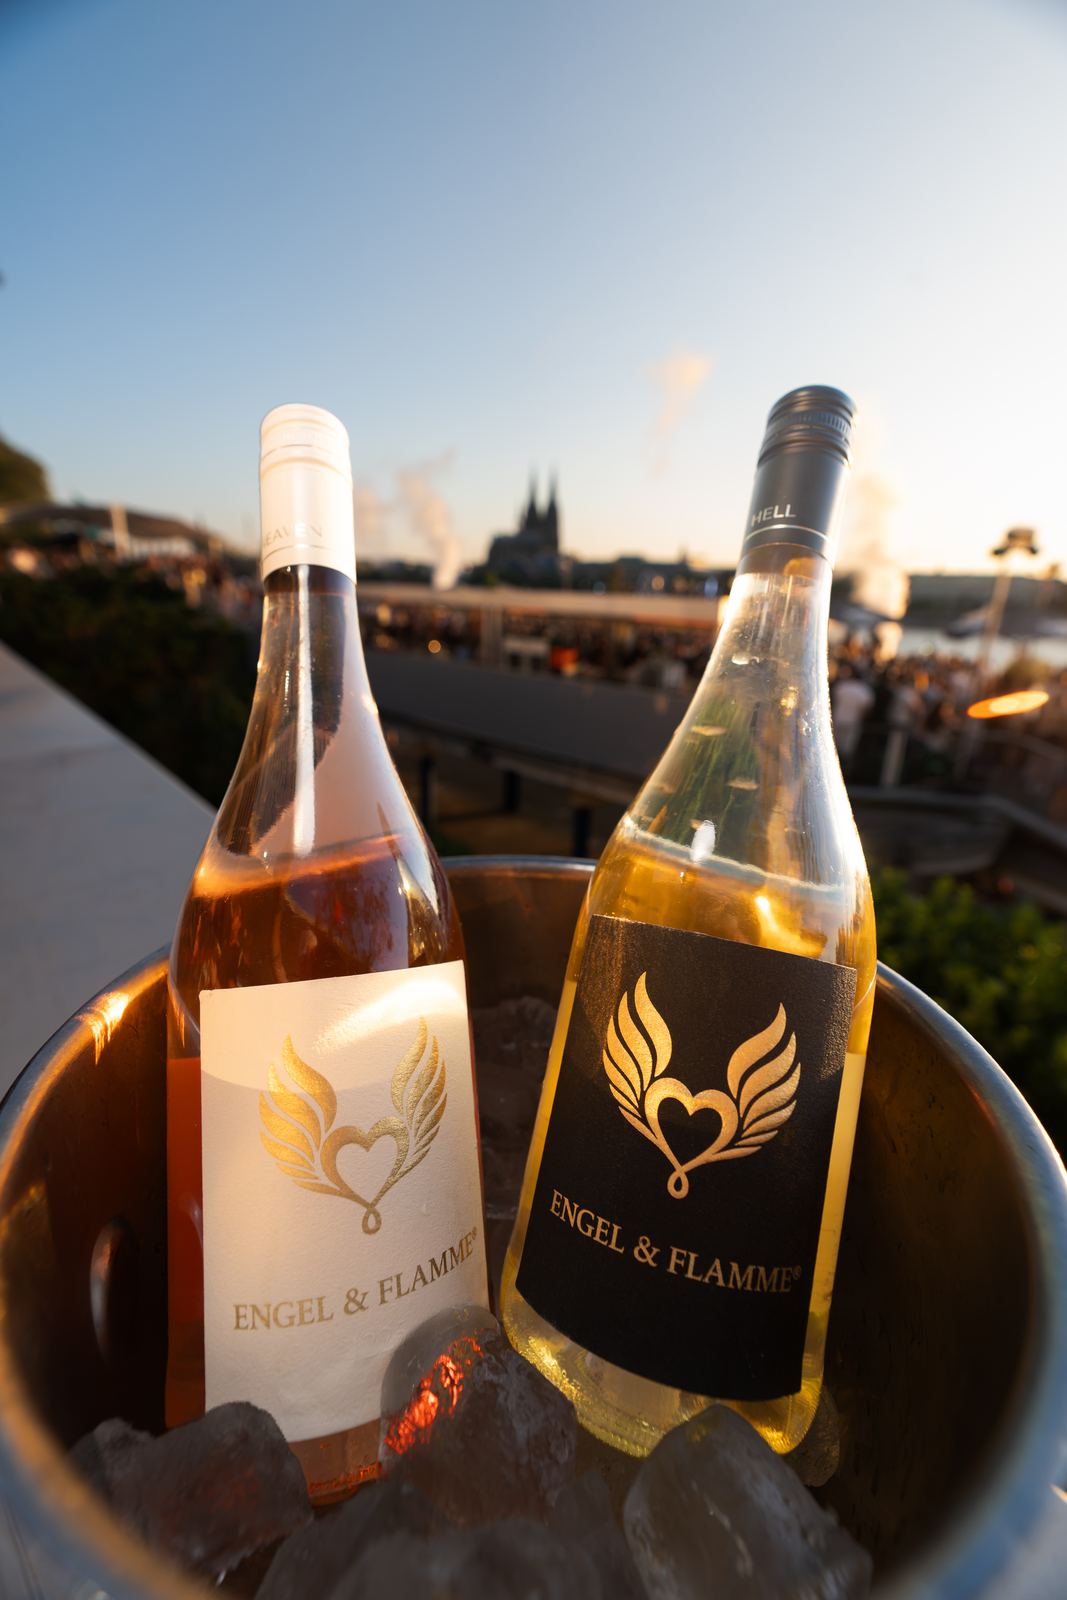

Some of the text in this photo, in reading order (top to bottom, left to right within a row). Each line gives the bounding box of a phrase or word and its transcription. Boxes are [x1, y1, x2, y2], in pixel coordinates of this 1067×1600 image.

[751, 504, 797, 527] HELL
[549, 1188, 625, 1254] ENGEL
[633, 1234, 662, 1268] &
[233, 1296, 334, 1331] ENGEL
[343, 1287, 369, 1316] &
